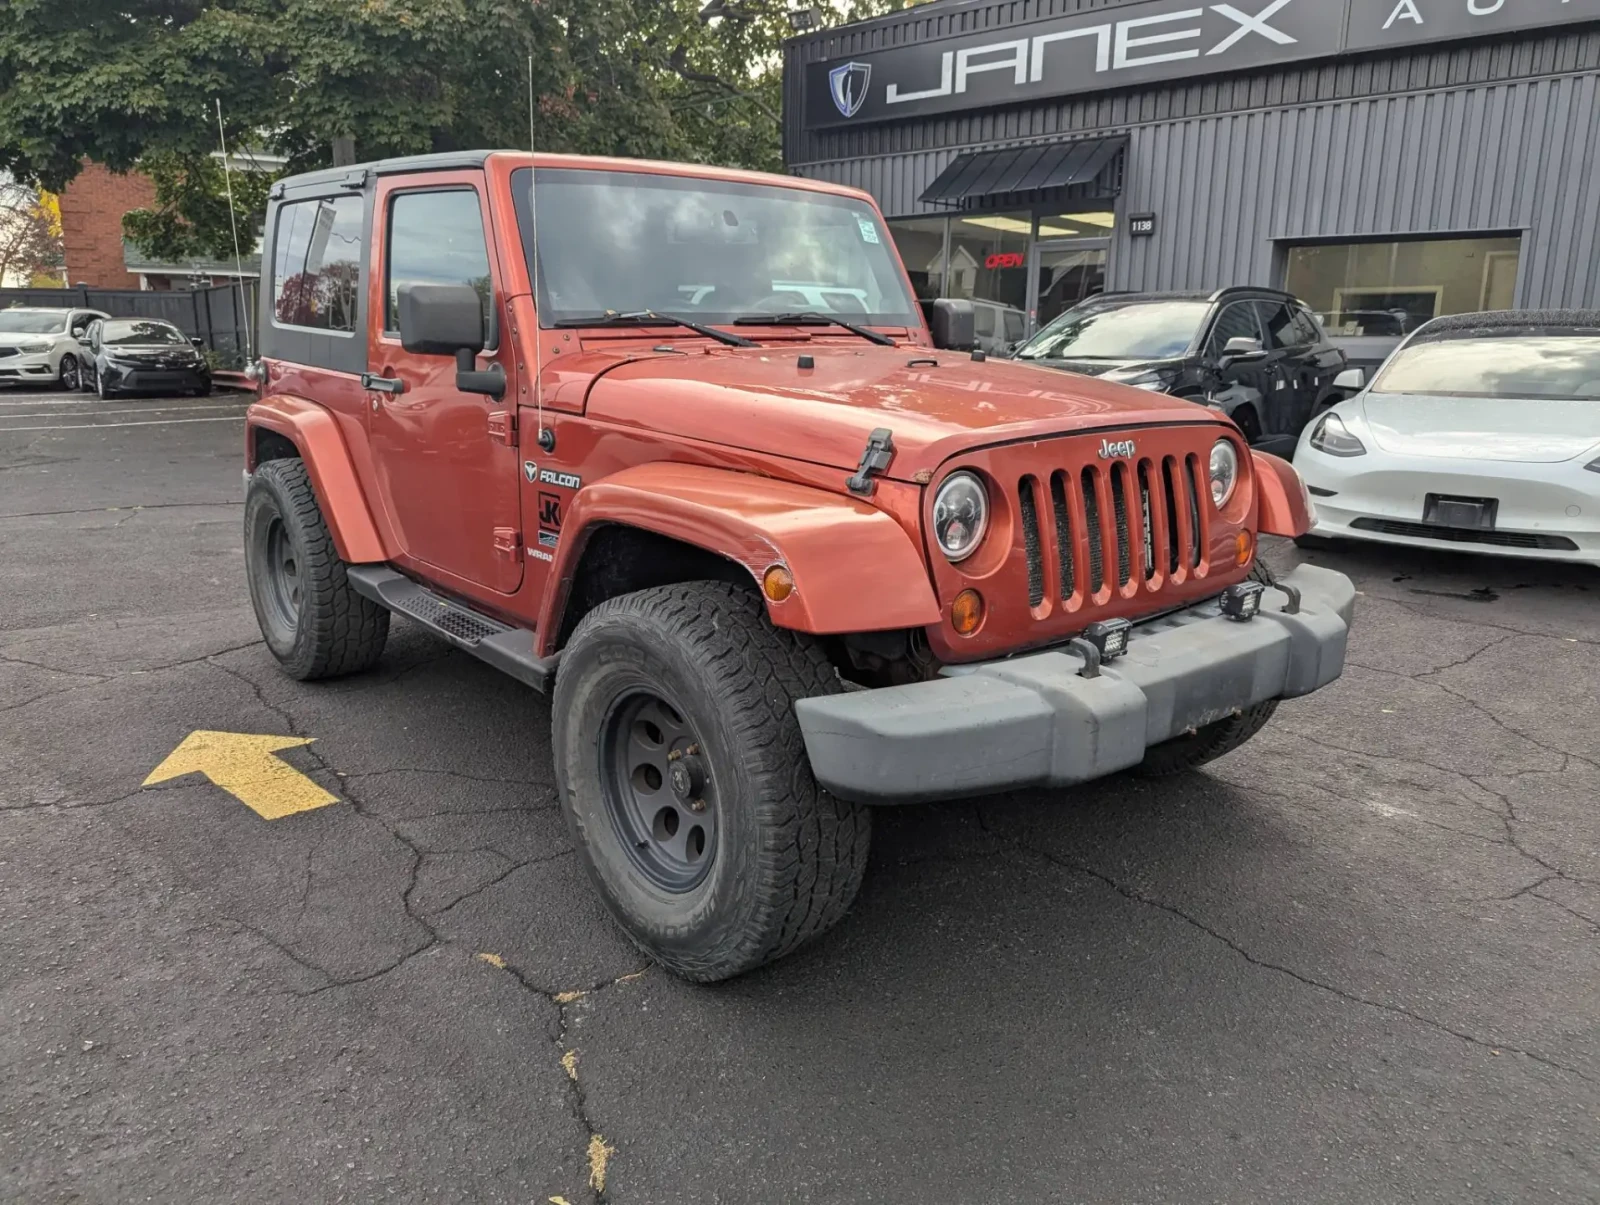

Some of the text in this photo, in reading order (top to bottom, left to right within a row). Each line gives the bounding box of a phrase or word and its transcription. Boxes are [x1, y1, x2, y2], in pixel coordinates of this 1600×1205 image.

[886, 0, 1570, 104] JANEX AU
[1132, 221, 1152, 231] 1138
[985, 253, 1024, 269] OPEN
[1098, 438, 1136, 459] Jeep
[540, 471, 580, 488] FALCON
[540, 500, 560, 526] JK
